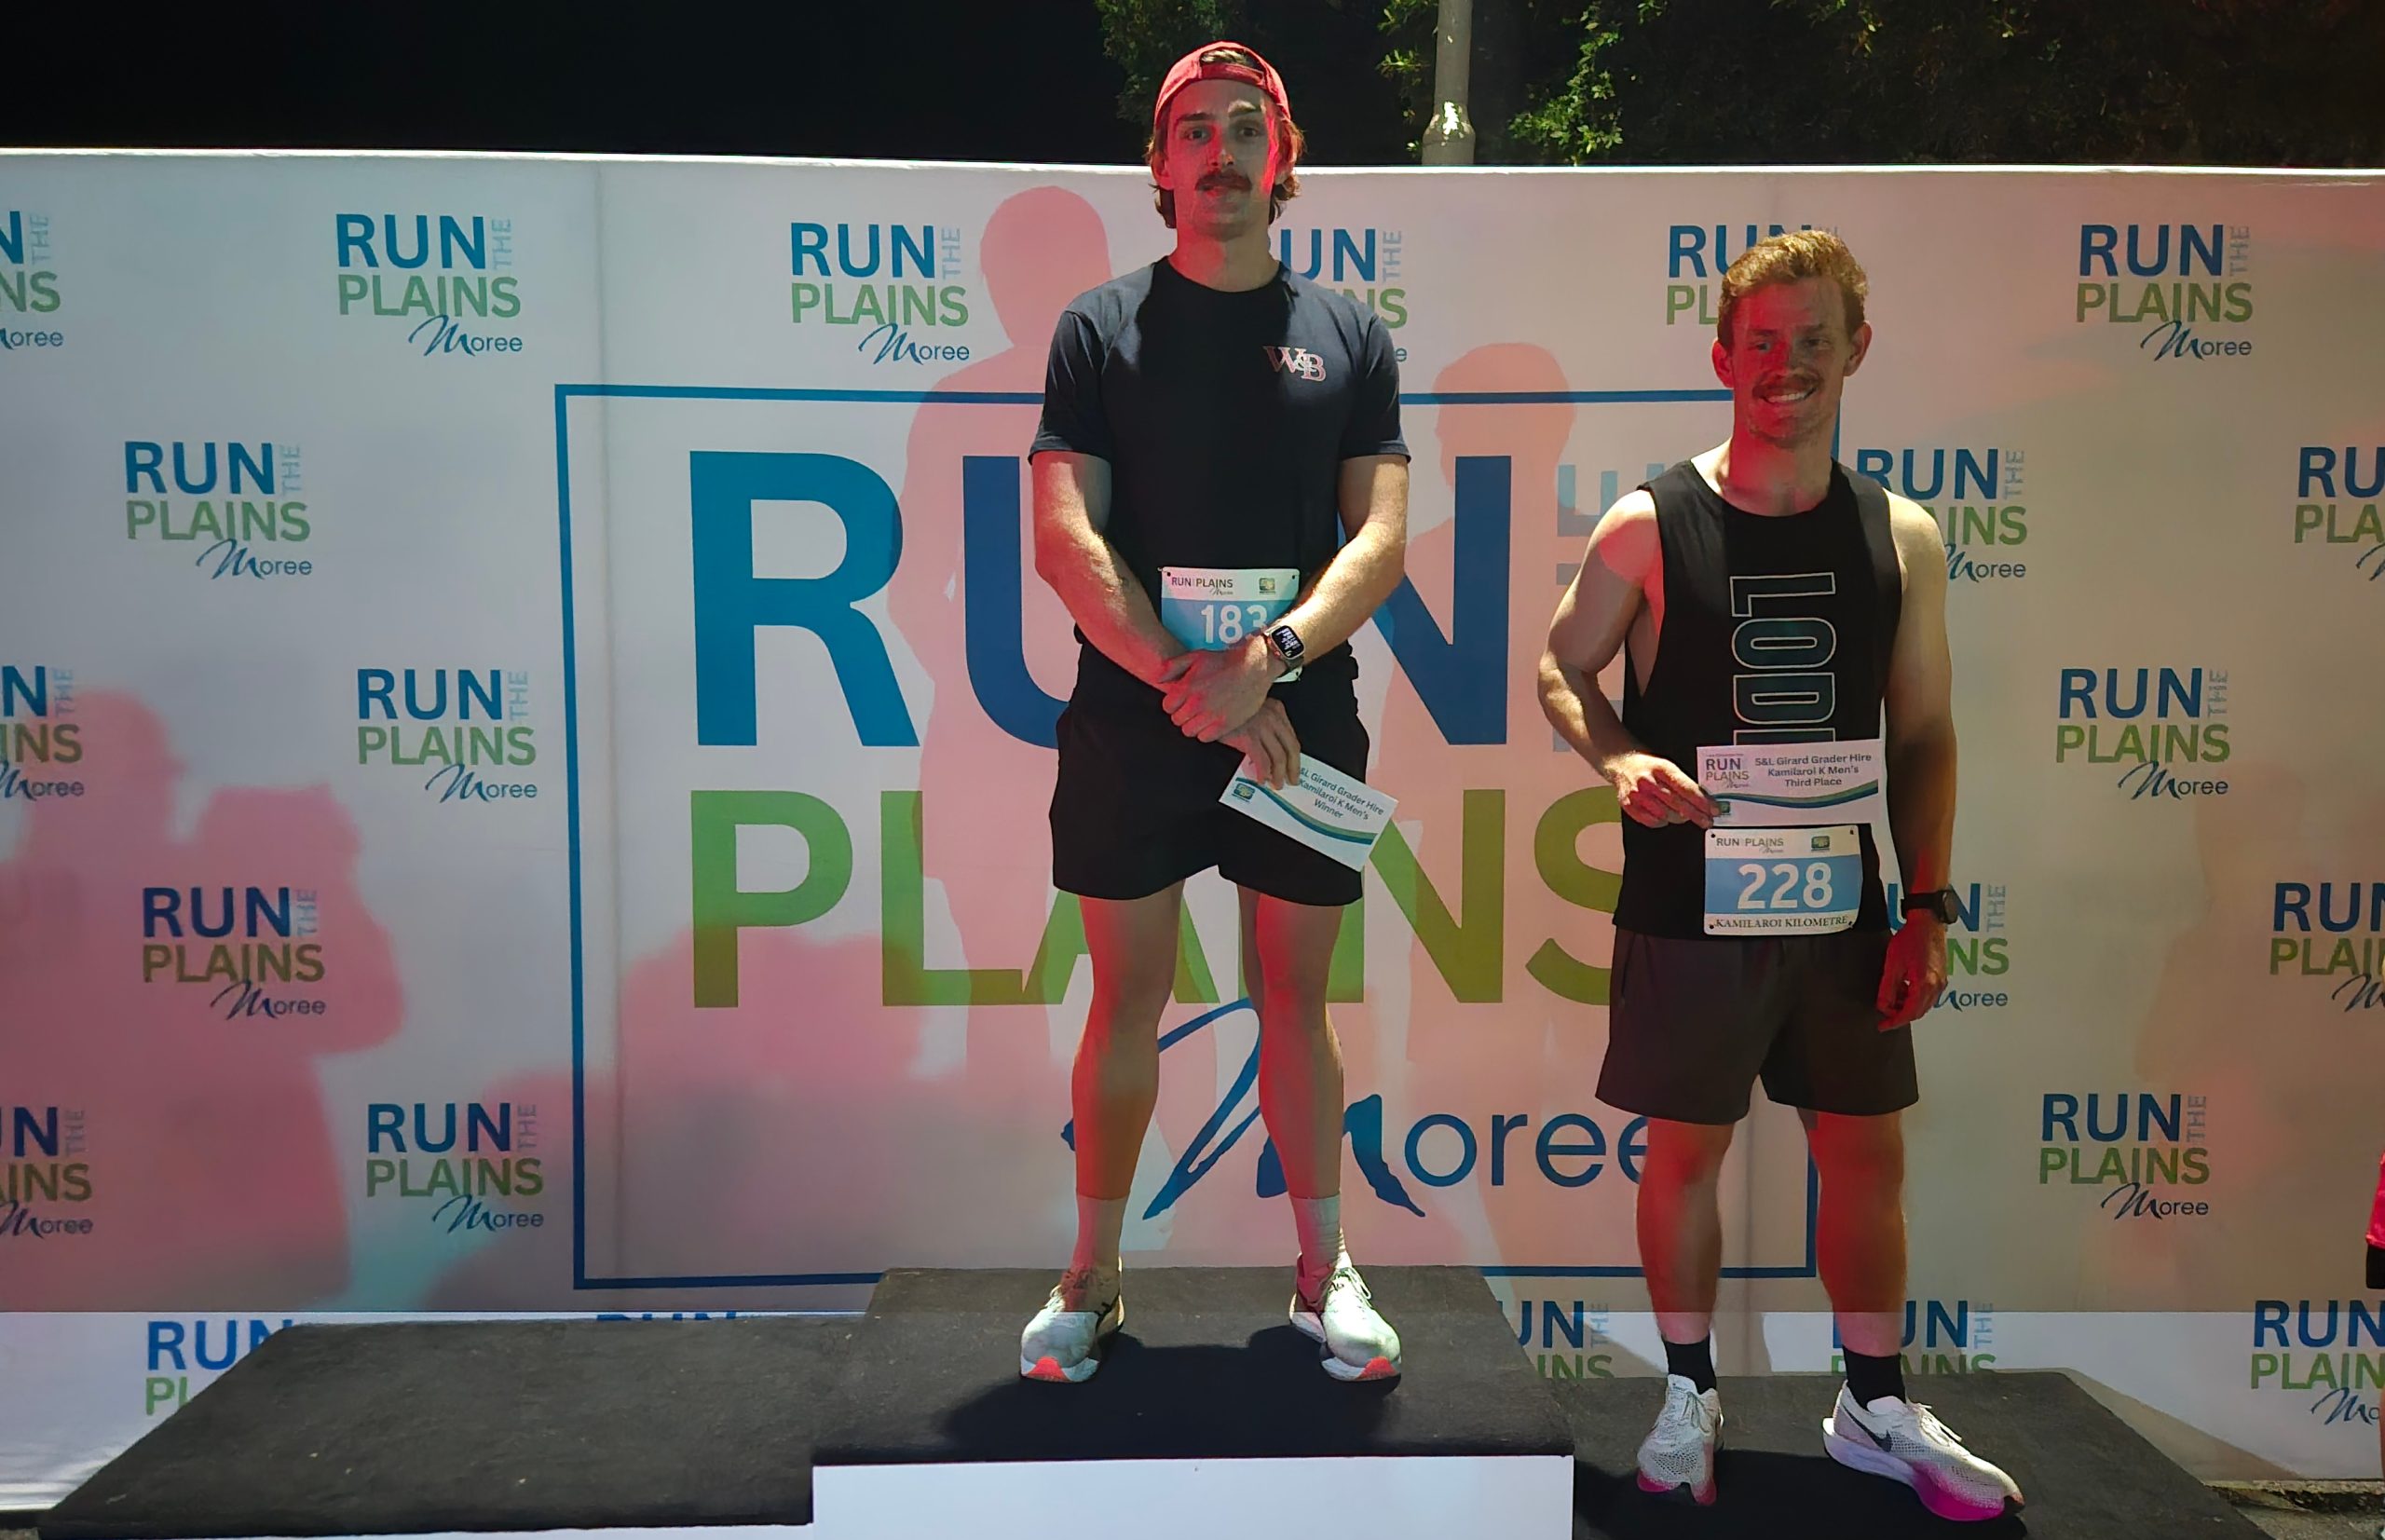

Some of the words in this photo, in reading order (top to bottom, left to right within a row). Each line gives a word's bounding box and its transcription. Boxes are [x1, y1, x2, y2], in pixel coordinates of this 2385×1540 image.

[335, 213, 486, 269] RUN
[492, 218, 512, 269] THE
[791, 223, 934, 278] RUN
[942, 226, 961, 278] THE
[1280, 228, 1376, 281] UN
[2078, 225, 2224, 277] RUN
[2228, 225, 2250, 276] THE
[337, 274, 521, 318] PLAINS
[791, 283, 970, 327] PLAINS
[2077, 282, 2253, 322] PLAINS
[408, 315, 523, 356] Moree
[858, 322, 970, 365] Moree
[2140, 320, 2252, 361] Moree
[124, 442, 275, 495] RUN
[281, 443, 301, 496] THE
[2298, 446, 2385, 497] RU
[126, 500, 310, 542] PLAINS
[196, 538, 312, 579] Moree
[1172, 577, 1192, 587] RUN
[1196, 578, 1233, 589] PLAINS
[357, 669, 502, 720] RUN
[508, 670, 529, 721] THE
[2059, 668, 2202, 719] RUN
[2208, 669, 2228, 719] THE
[358, 726, 537, 766] PLAINS
[1706, 758, 1741, 770] RUN
[1777, 756, 1809, 766] Girard
[1811, 755, 1847, 764] Grader
[1849, 753, 1872, 763] Hire
[2055, 724, 2230, 763] PLAINS
[425, 762, 538, 803] Moree
[1706, 770, 1749, 782] PLAINS
[1785, 779, 1811, 788] Third
[1814, 777, 1843, 786] Place
[1819, 767, 1826, 776] K
[2118, 760, 2228, 800] Moree
[1311, 772, 1341, 791] Girard
[1338, 786, 1366, 805] Grader
[1366, 800, 1384, 815] Hire
[1314, 798, 1344, 819] Winner
[1338, 798, 1345, 807] K
[1716, 838, 1739, 847] RUN
[1745, 837, 1784, 849] PLAINS
[1738, 862, 1833, 909] 228
[142, 886, 292, 938] RUN
[296, 889, 319, 938] THE
[1716, 918, 1782, 929] KAMILAROI
[1785, 915, 1848, 928] KILOMETRE
[142, 944, 324, 983] PLAINS
[2269, 937, 2385, 975] PLAI
[210, 979, 326, 1020] Moree
[367, 1103, 511, 1153] RUN
[517, 1103, 538, 1152] THE
[2041, 1093, 2182, 1142] RUN
[2187, 1095, 2207, 1142] THE
[366, 1158, 544, 1197] PLAINS
[2039, 1147, 2210, 1184] PLAINS
[432, 1194, 544, 1233] Moree
[2100, 1182, 2209, 1220] Moree
[2251, 1353, 2385, 1390] PLAIN
